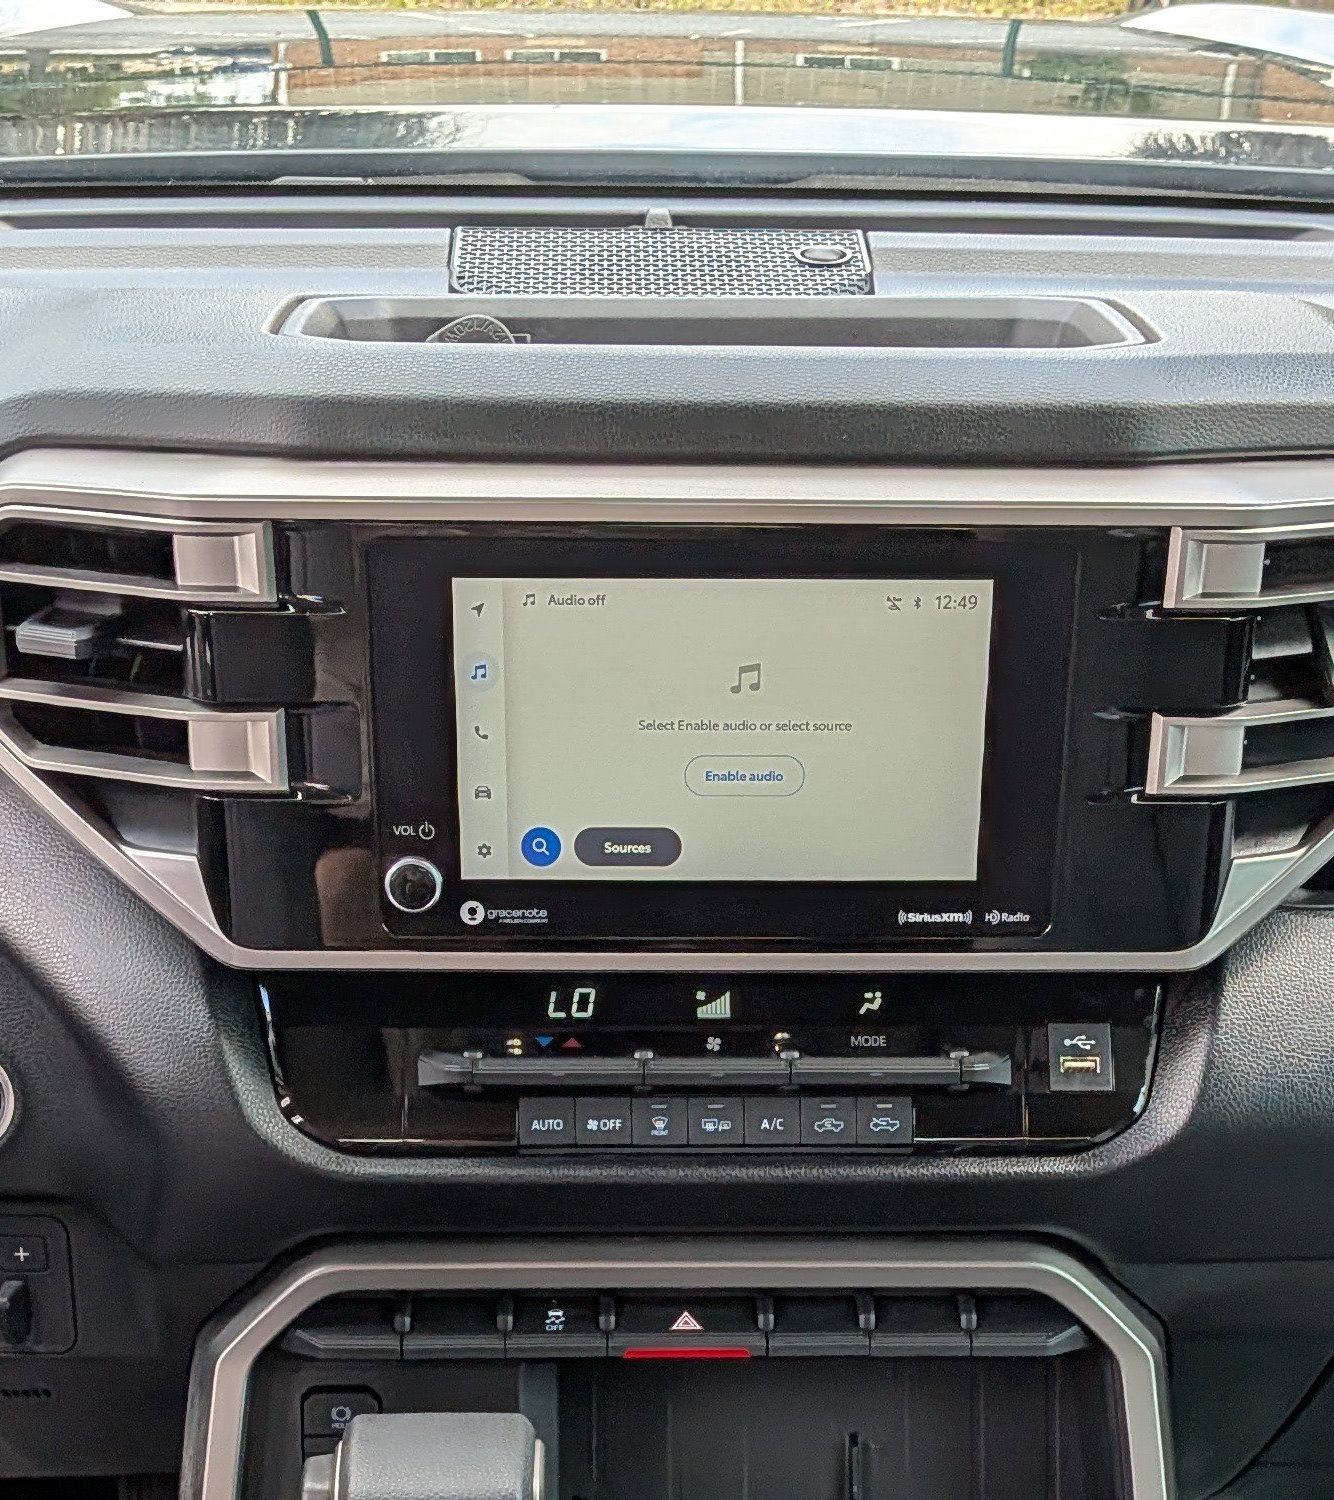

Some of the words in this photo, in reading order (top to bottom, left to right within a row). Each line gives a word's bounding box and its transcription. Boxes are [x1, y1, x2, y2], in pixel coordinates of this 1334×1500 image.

[547, 594, 586, 606] Audio
[587, 594, 607, 606] off
[935, 594, 978, 611] 12:49
[638, 719, 675, 731] Select
[678, 719, 719, 731] Enable
[722, 719, 757, 732] audio
[759, 721, 773, 732] or
[775, 719, 810, 732] select
[812, 721, 853, 732] source
[705, 770, 747, 782] Enable
[748, 770, 784, 782] audio
[392, 825, 417, 836] VOL
[603, 841, 652, 854] Sources
[486, 907, 548, 920] gracenote
[1001, 913, 1030, 922] Radio
[547, 987, 596, 1019] LO
[850, 1035, 887, 1048] MODE
[531, 1118, 564, 1131] AUTO
[600, 1118, 622, 1131] OFF
[760, 1118, 784, 1131] A/C
